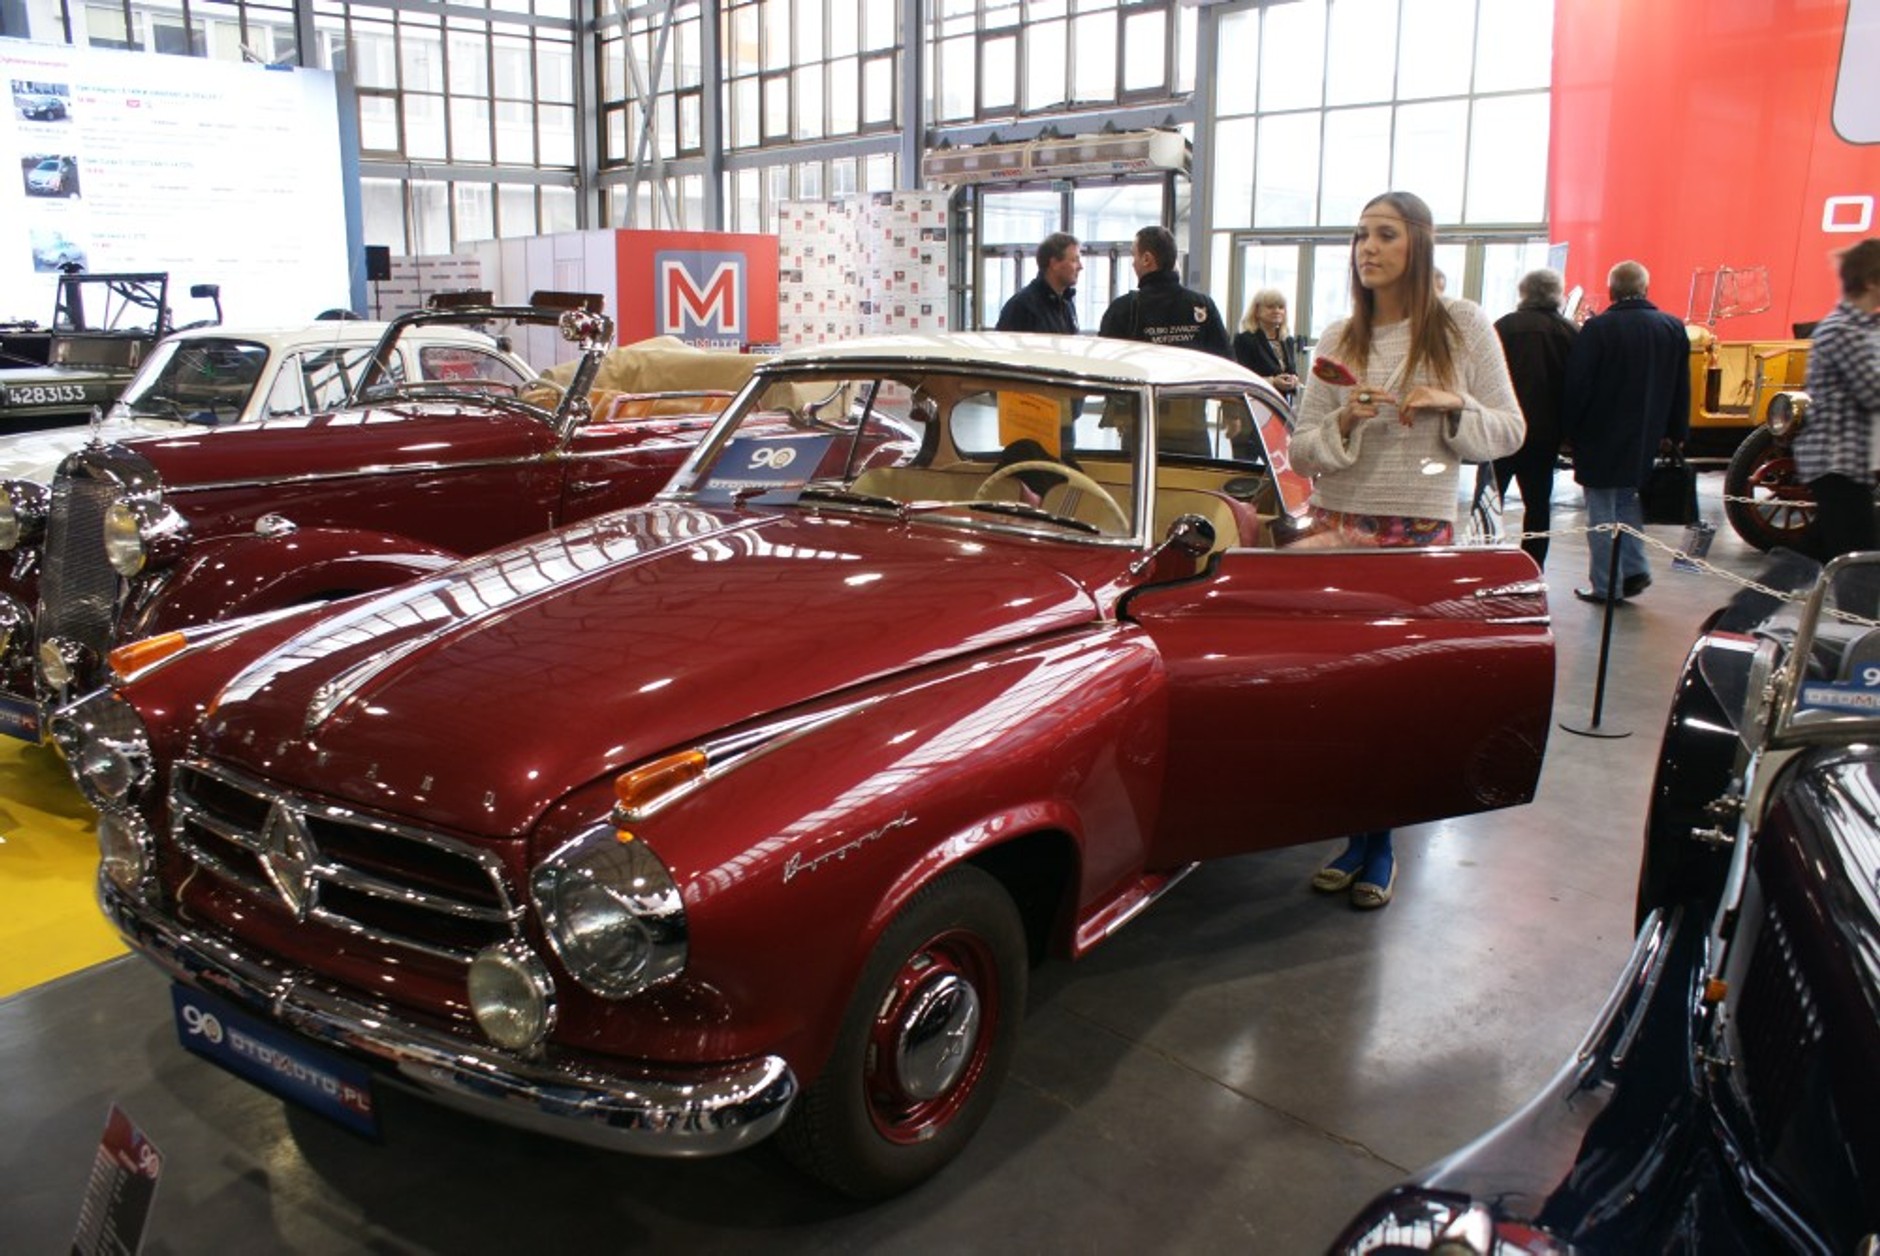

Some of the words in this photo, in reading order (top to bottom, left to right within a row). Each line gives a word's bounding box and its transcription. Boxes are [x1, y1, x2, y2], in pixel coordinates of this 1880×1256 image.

[662, 260, 740, 334] M
[10, 385, 86, 404] 4283133
[747, 446, 798, 470] 90
[182, 1004, 223, 1044] 90
